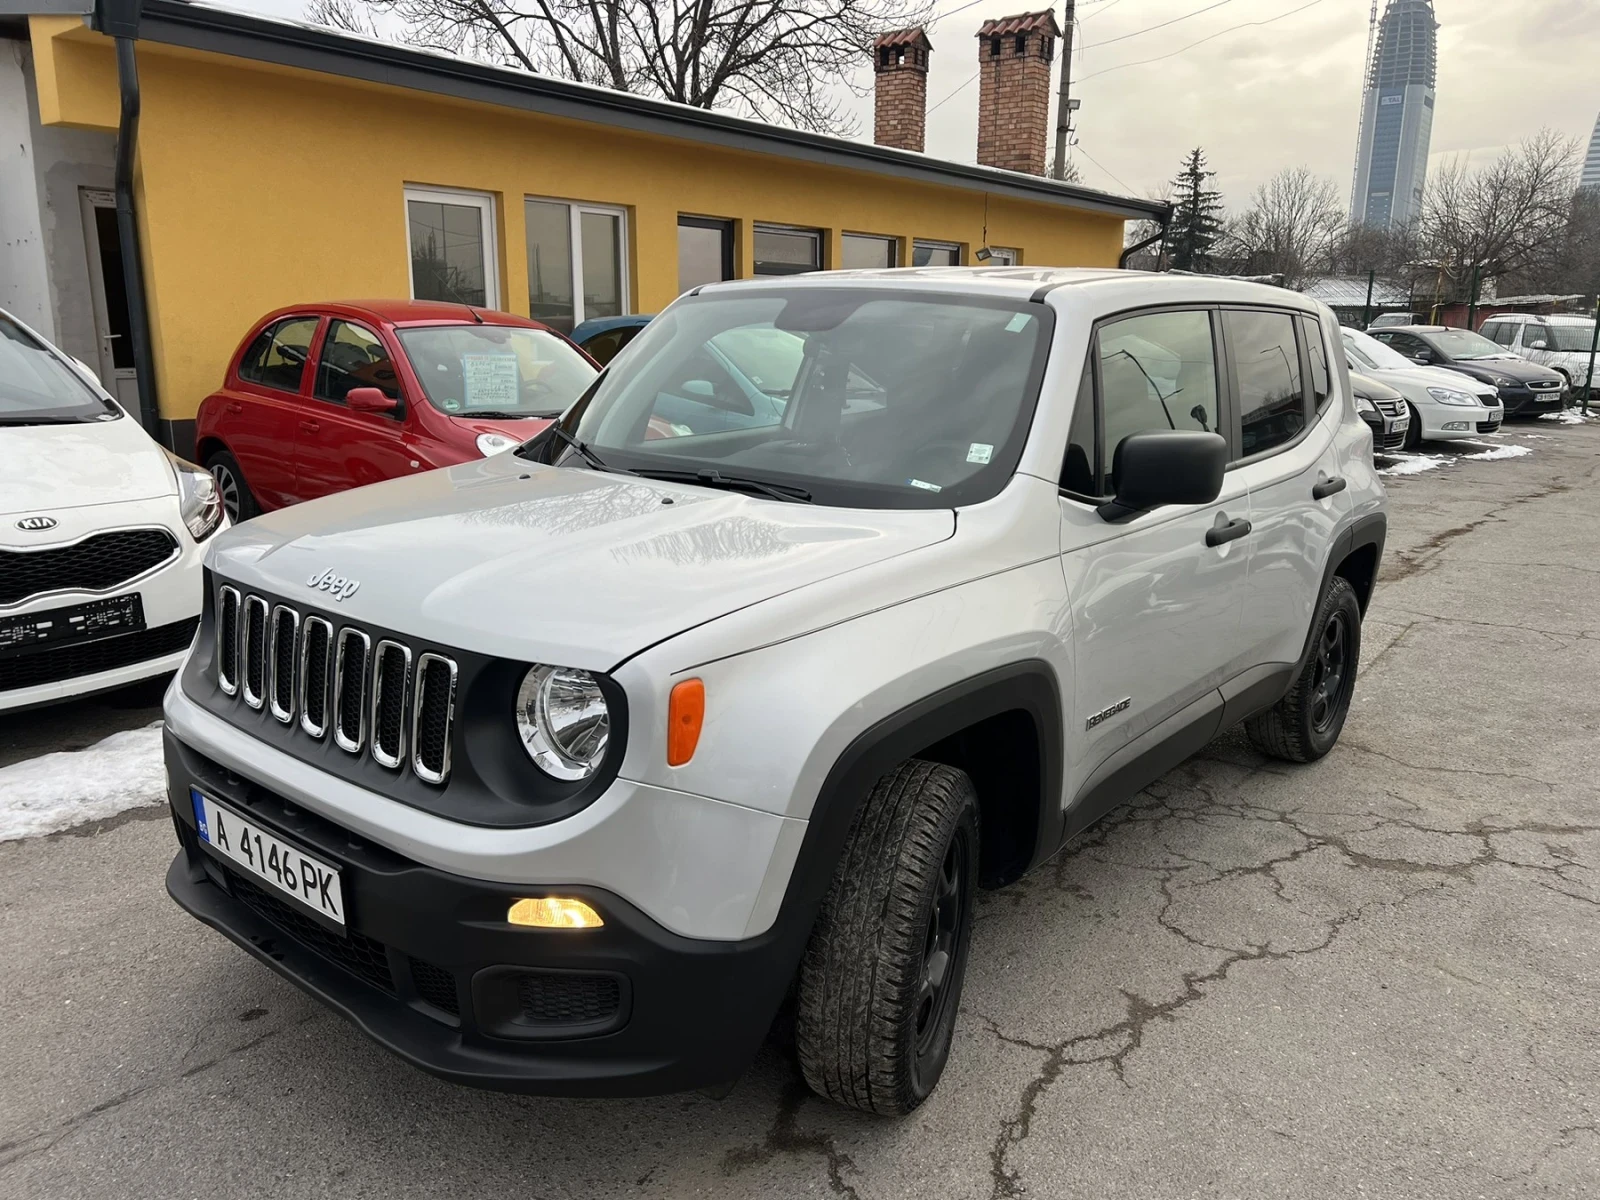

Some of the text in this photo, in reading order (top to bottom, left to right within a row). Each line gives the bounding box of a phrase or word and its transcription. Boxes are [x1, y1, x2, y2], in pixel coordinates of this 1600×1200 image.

[21, 518, 55, 529] KIA
[306, 567, 360, 602] Jeep
[1085, 696, 1131, 731] RENEGADE
[216, 810, 230, 851] A
